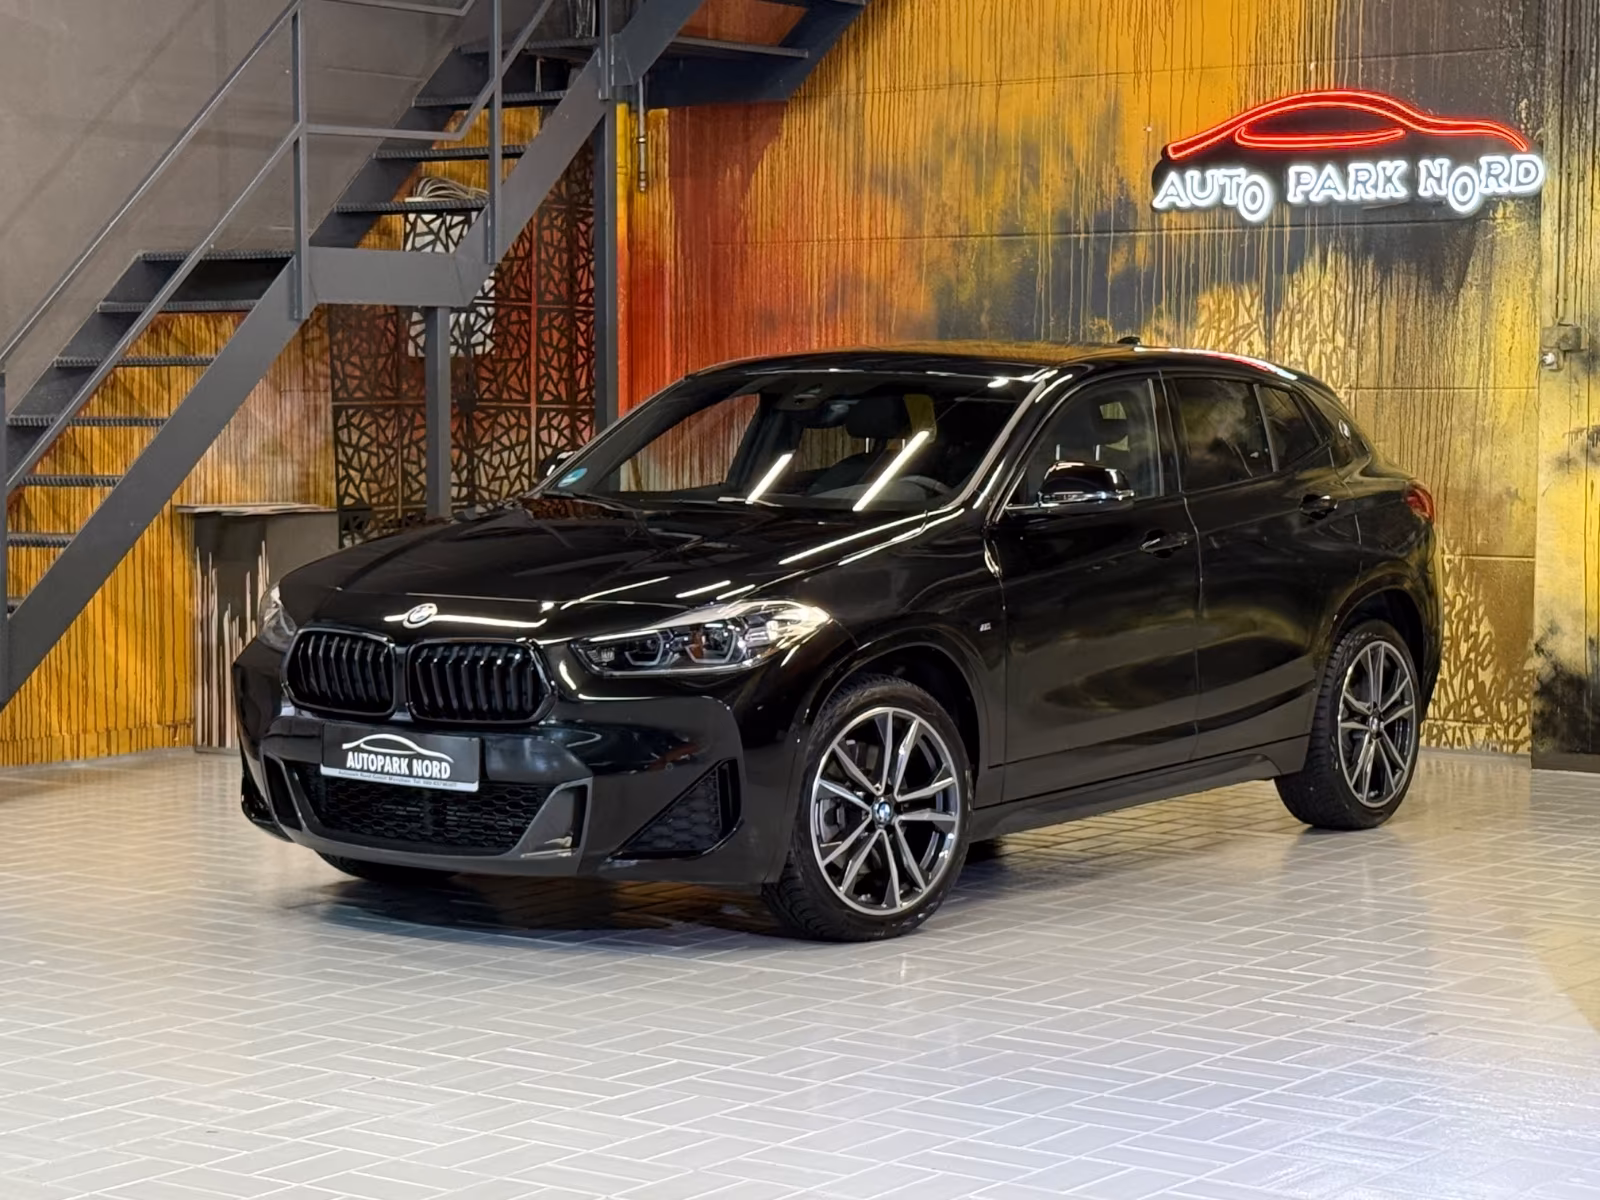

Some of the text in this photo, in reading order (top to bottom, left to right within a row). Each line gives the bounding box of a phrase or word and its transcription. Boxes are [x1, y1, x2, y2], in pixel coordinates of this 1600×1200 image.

[1152, 153, 1546, 222] AUTO PARK NORD
[346, 751, 410, 776] AUTOPARK
[412, 758, 451, 779] NORD
